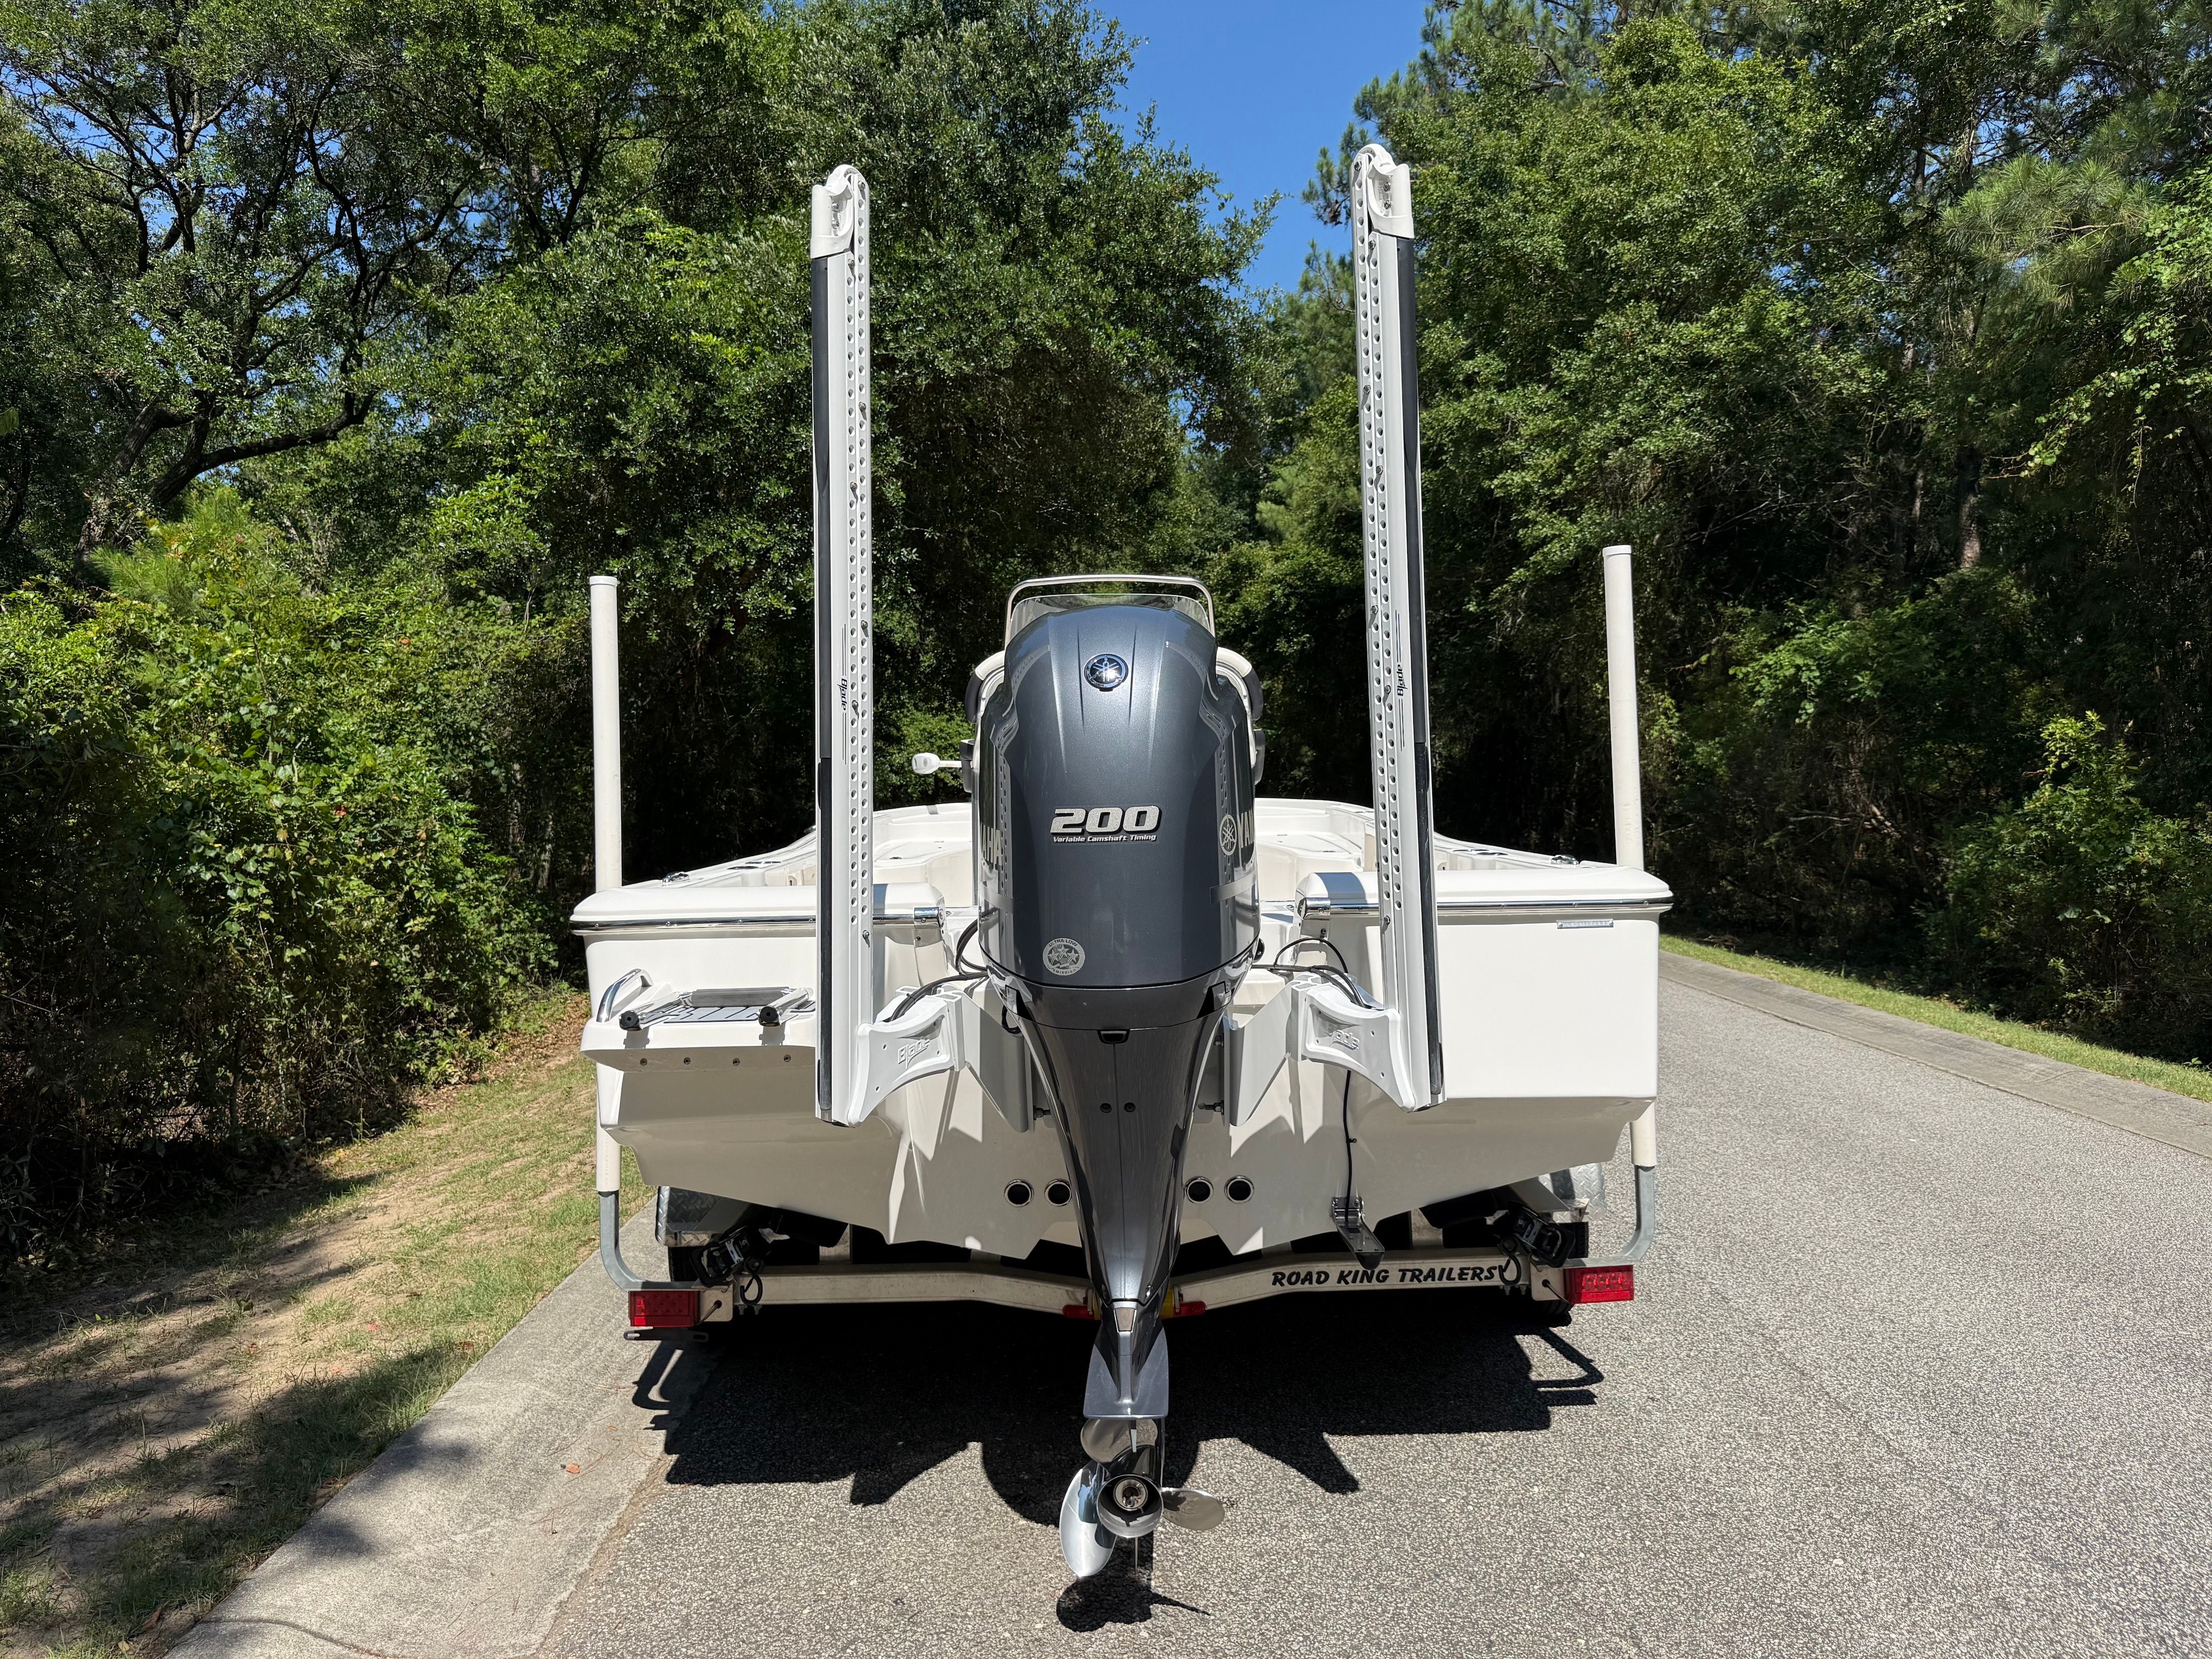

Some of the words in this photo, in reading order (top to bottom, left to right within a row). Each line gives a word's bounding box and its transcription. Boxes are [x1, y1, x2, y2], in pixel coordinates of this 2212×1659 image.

[837, 678, 847, 711] Blade
[1396, 664, 1409, 696] Blade
[1050, 806, 1161, 835] 200
[898, 1037, 930, 1070] Blade
[1271, 1270, 1330, 1287] ROAD
[1336, 1269, 1390, 1285] KING
[1398, 1265, 1498, 1282] TRAILERS
